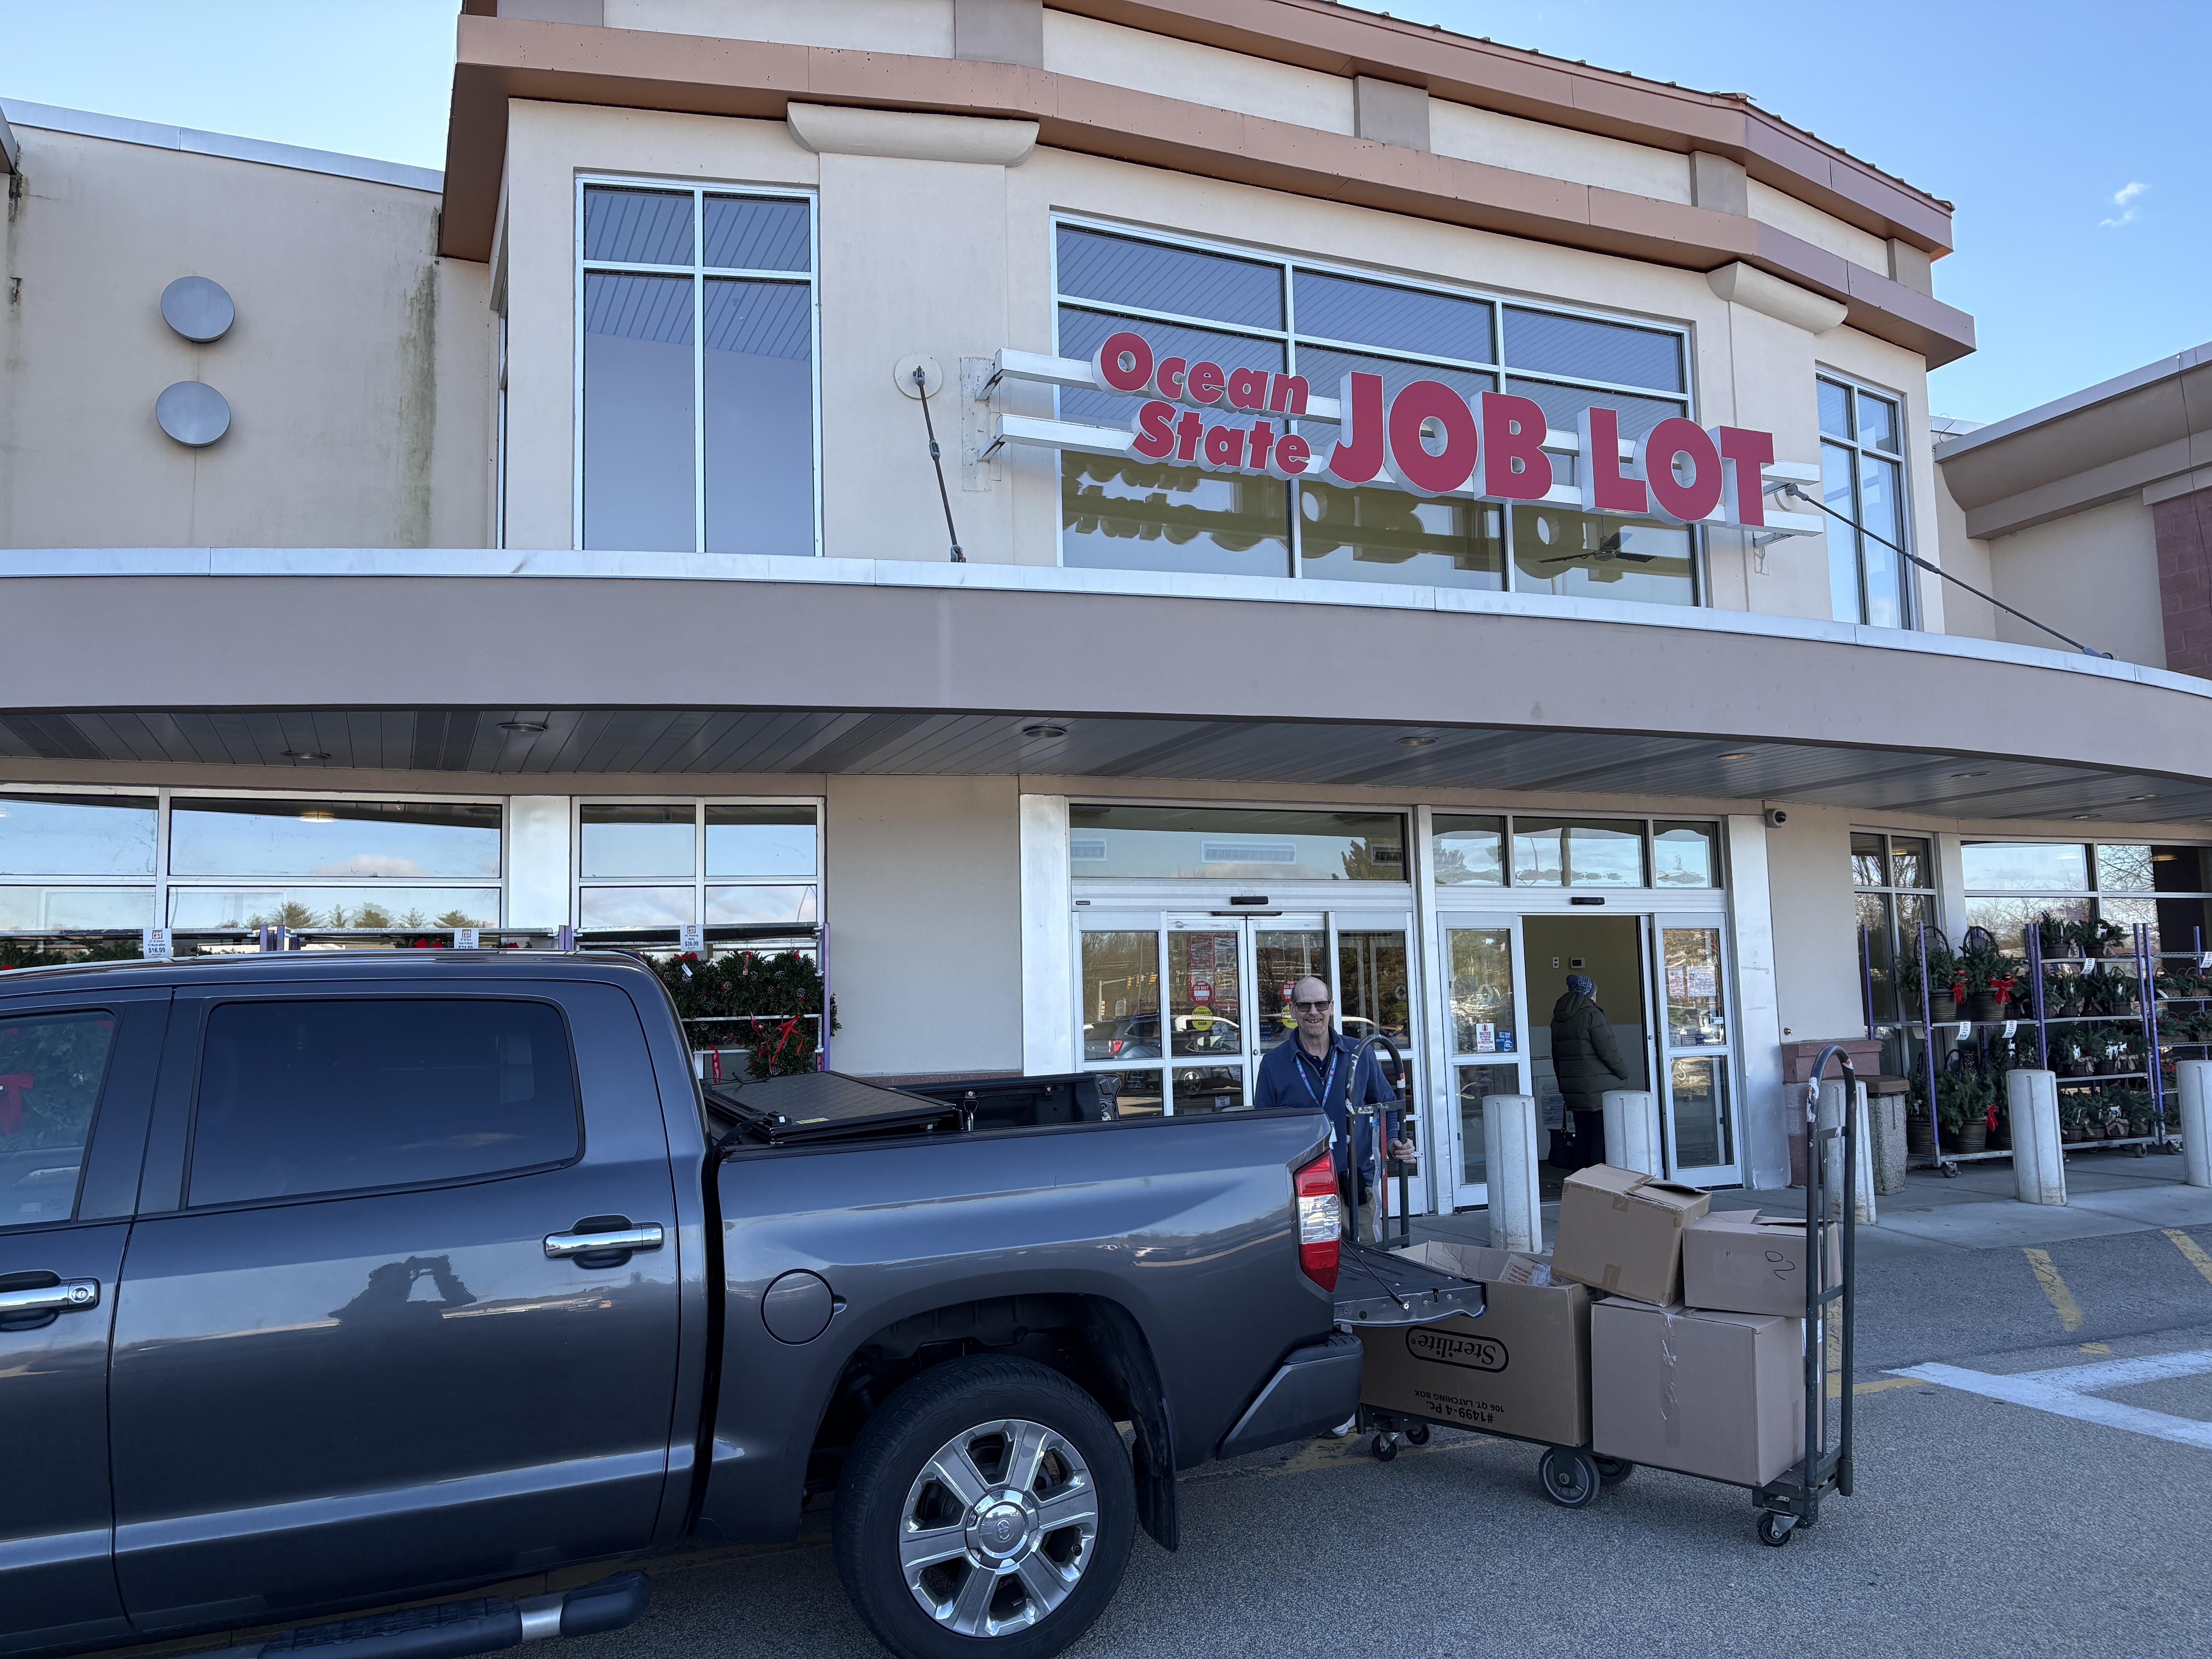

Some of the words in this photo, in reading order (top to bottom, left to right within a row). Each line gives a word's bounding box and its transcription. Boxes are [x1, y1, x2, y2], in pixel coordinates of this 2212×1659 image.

[1100, 332, 1309, 416] Ocean
[1133, 401, 1310, 475] State
[1328, 371, 1553, 500] JOB
[1589, 407, 1774, 527] LOT
[1418, 1334, 1496, 1365] Sterilite
[1414, 1389, 1431, 1399] BOX
[1433, 1393, 1473, 1407] LATCHING
[1445, 1404, 1494, 1424] #1499-4
[1475, 1401, 1488, 1410] QT.
[1490, 1404, 1504, 1412] 106
